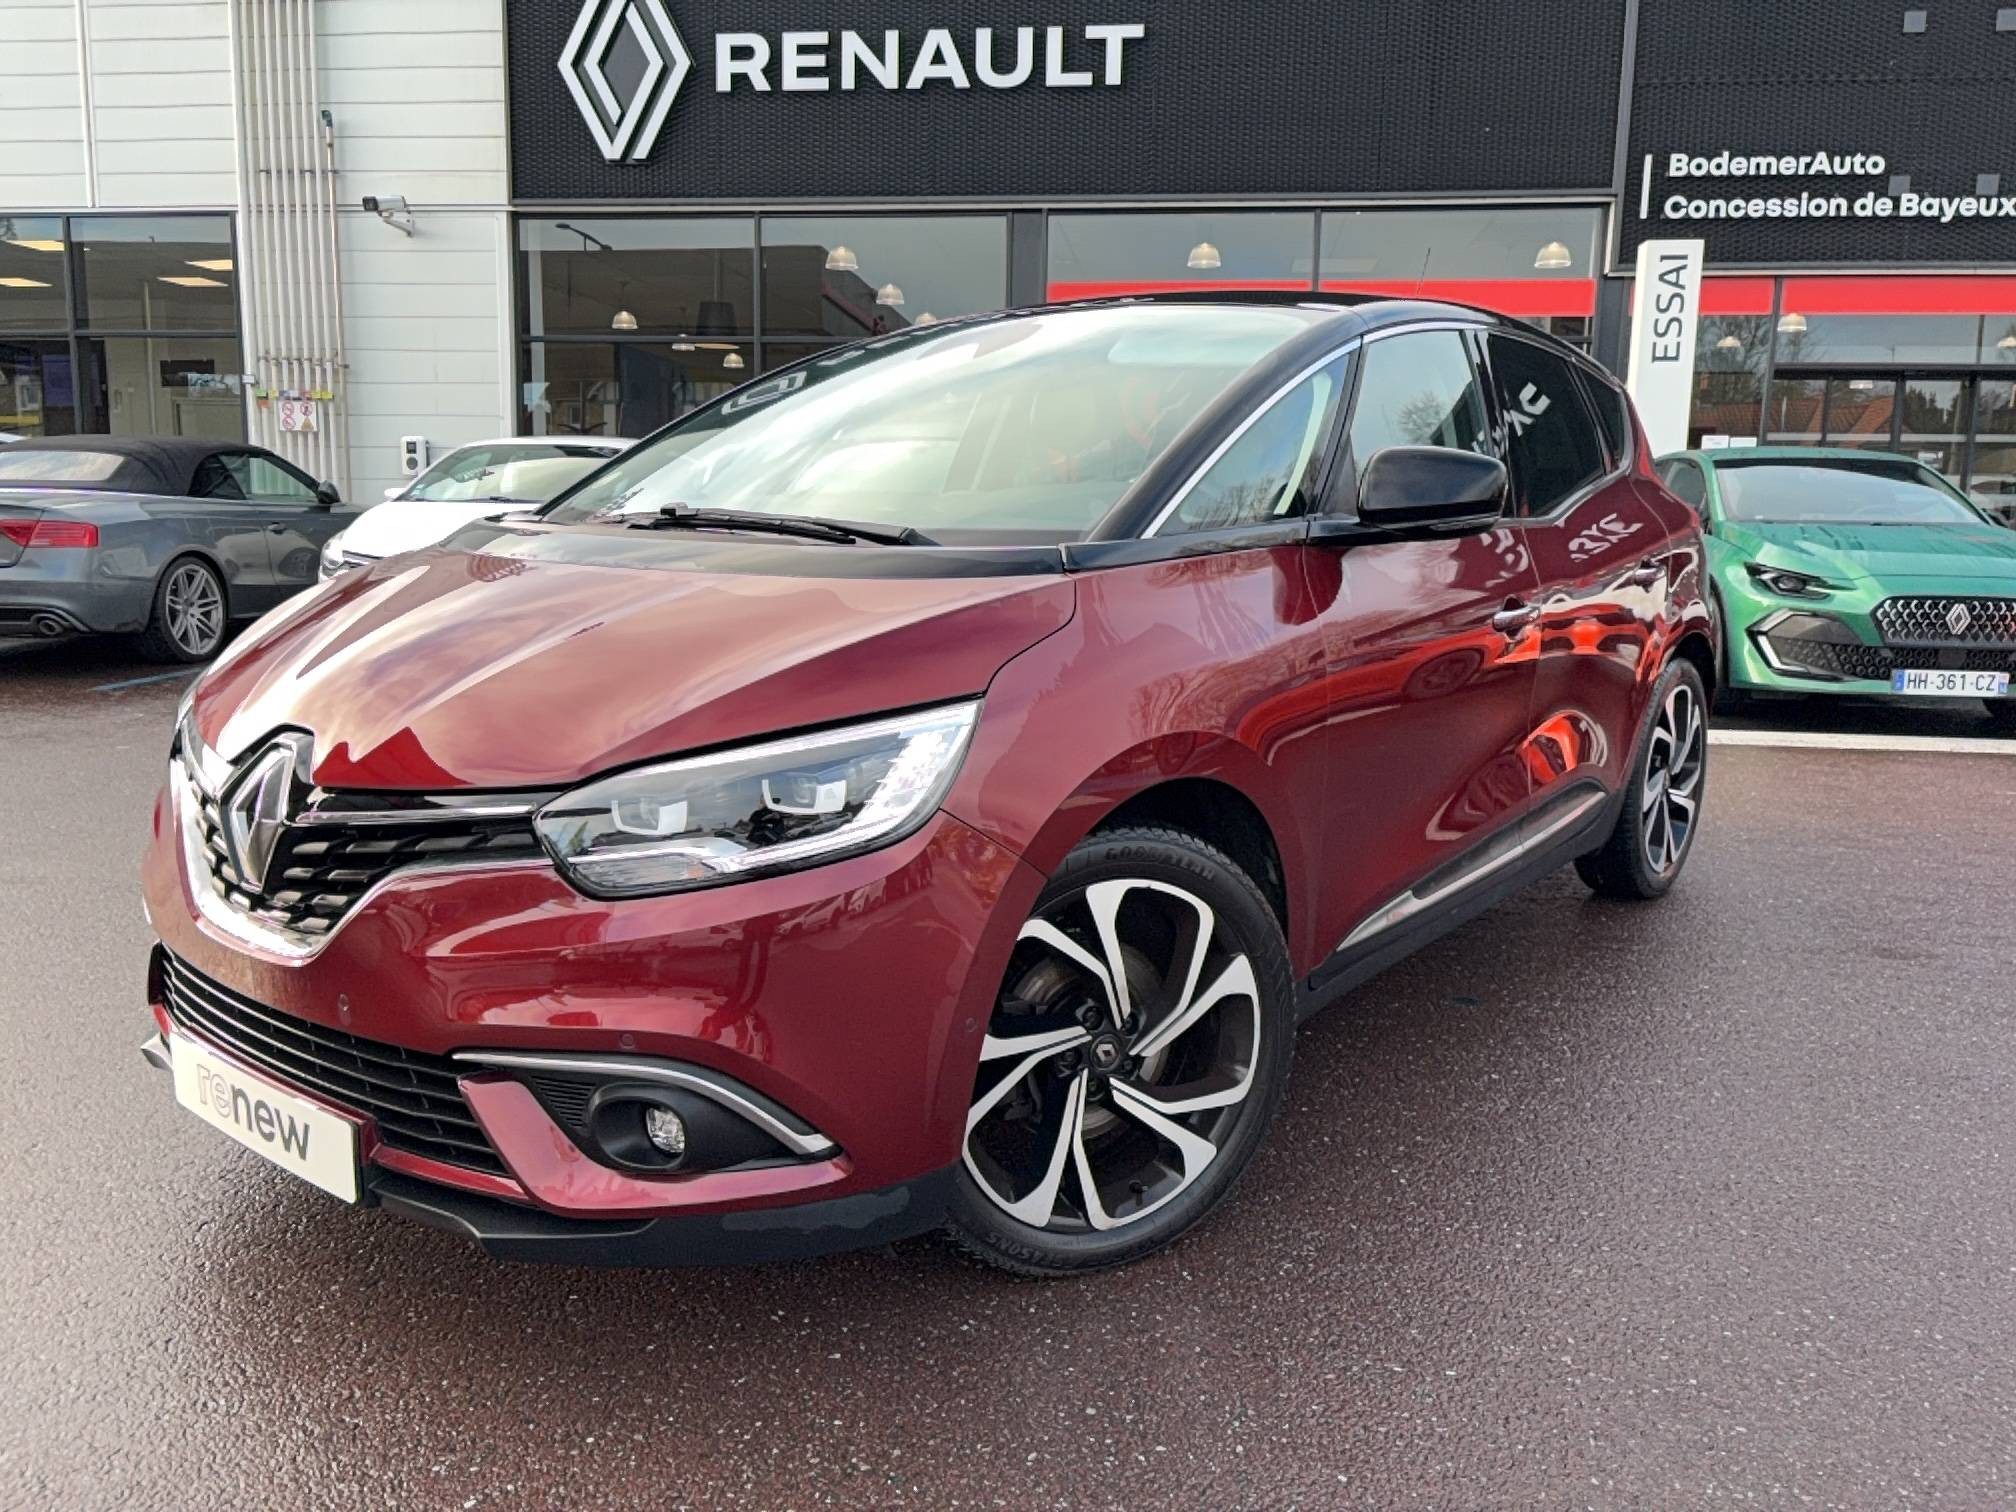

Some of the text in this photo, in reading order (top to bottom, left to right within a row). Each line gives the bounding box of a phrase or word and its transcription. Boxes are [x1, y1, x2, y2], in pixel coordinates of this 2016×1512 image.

[715, 23, 1146, 93] RENAULT
[1667, 151, 1886, 177] BodemerAuto
[1664, 192, 2016, 223] Concession de Bayeux
[1651, 254, 1689, 363] ESSAI
[1906, 673, 1997, 691] HH-361-CZ
[196, 1063, 310, 1161] renew
